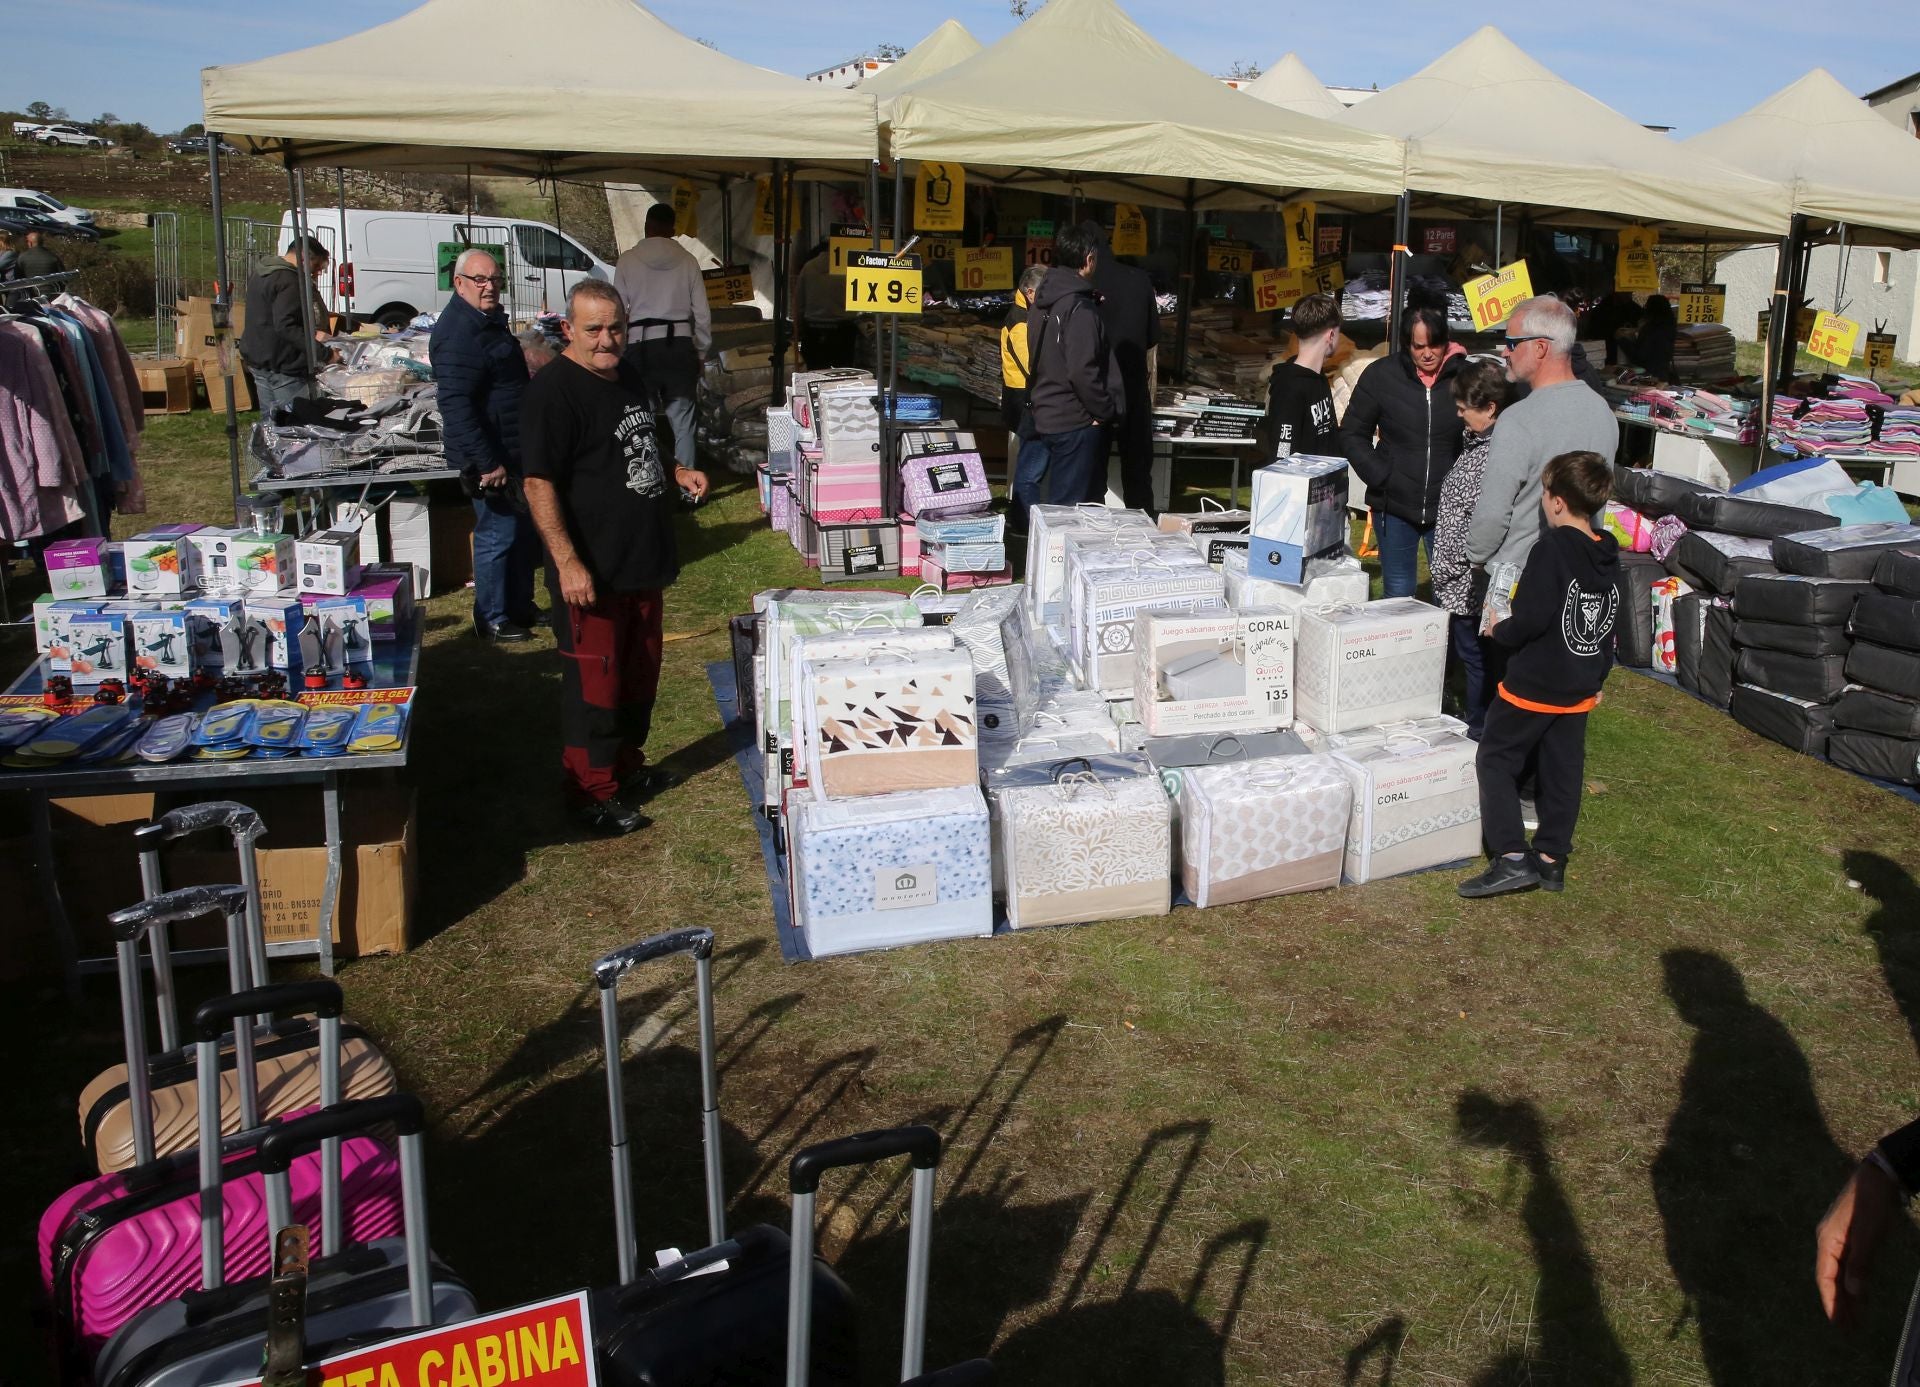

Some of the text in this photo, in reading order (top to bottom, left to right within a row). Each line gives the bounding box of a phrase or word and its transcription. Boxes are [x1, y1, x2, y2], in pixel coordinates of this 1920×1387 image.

[1426, 230, 1456, 240] 12 Pares
[1428, 243, 1442, 252] 5
[866, 256, 913, 267] Factory ALUCINE
[1028, 248, 1052, 264] 10
[1220, 256, 1240, 270] 20
[962, 267, 983, 288] 10
[1317, 274, 1332, 293] 15
[1479, 271, 1515, 294] ALUCINE
[851, 278, 858, 301] 1
[1257, 285, 1277, 308] 15
[1478, 297, 1503, 326] 10
[614, 411, 656, 442] MOTORCYCL
[1248, 620, 1290, 632] CORAL
[1576, 643, 1598, 651] MMXX
[1346, 648, 1376, 660] CORAL
[1265, 689, 1288, 700] 135
[1396, 774, 1422, 785] sábanas
[1378, 792, 1409, 805] CORAL
[292, 912, 308, 920] PCS
[418, 1316, 580, 1387] CABINA
